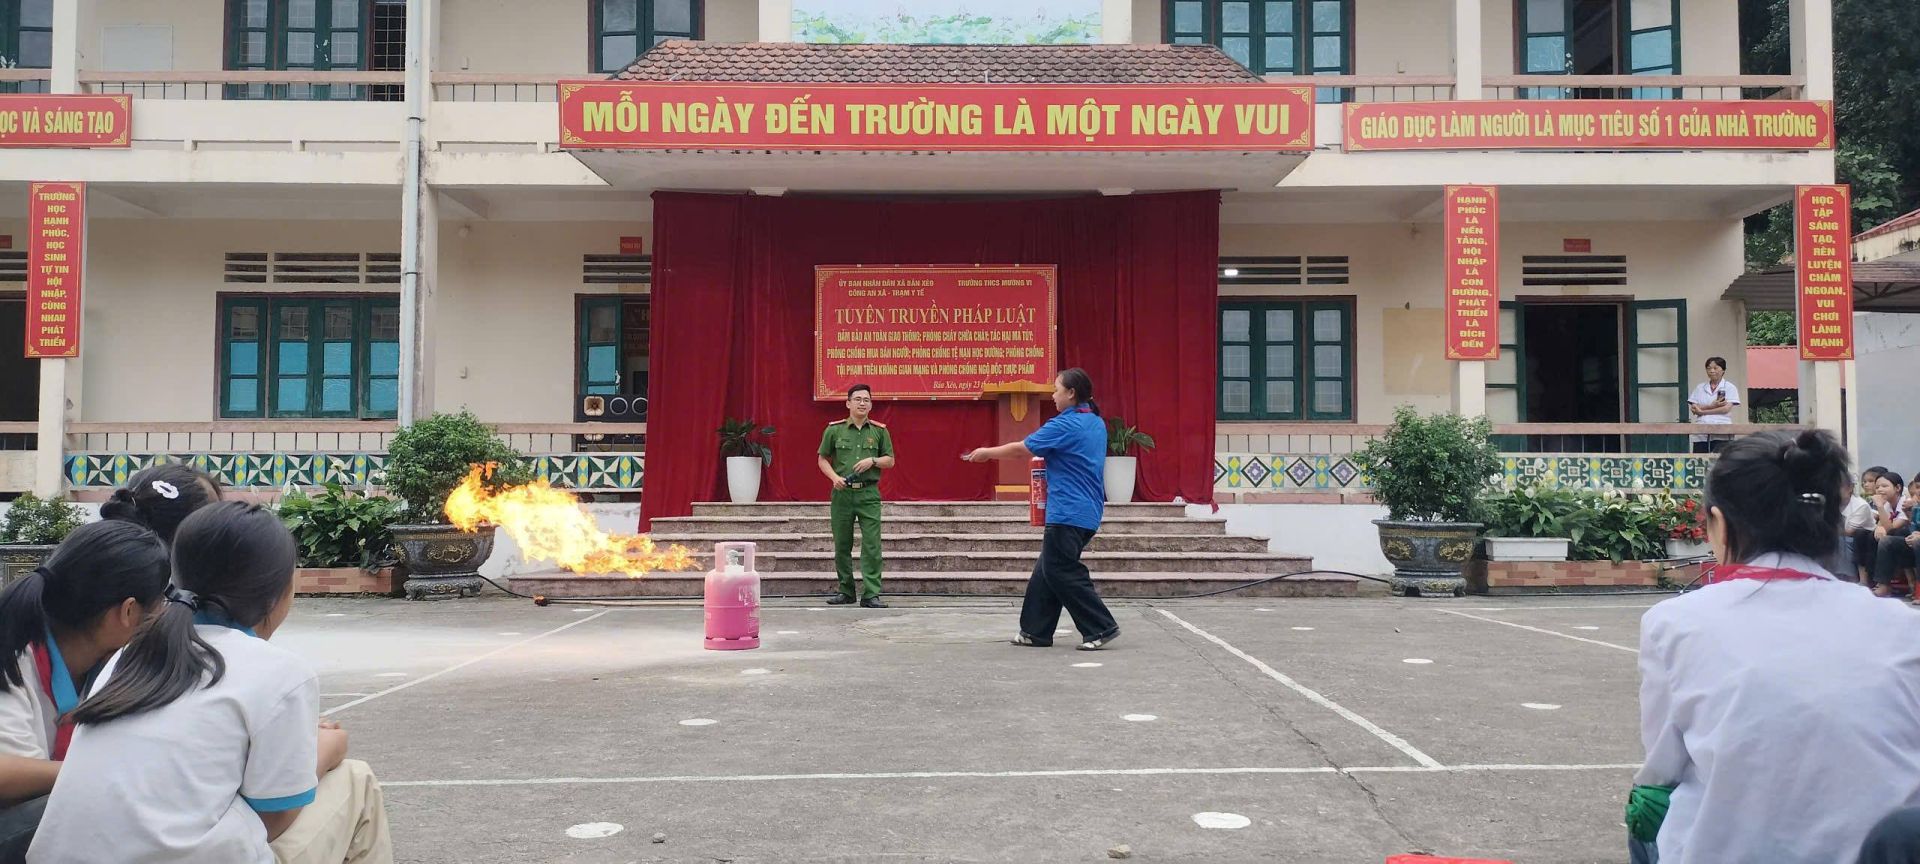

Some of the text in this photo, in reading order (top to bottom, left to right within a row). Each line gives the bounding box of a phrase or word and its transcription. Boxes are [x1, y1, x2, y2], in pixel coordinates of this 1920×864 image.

[582, 91, 1289, 142] MỖI NGÀY ĐẾN TRƯỜNG LÀ MỘT NGÀY VUI
[22, 106, 40, 133] VÀ
[45, 106, 83, 133] SÁNG
[88, 111, 114, 138] TẠO
[1360, 106, 1817, 142] GIÁO DỤC LÀM NGƯỜI LÀ MỤC TIÊU SỐ 1 CỦA NHÀ TRƯỜNG
[39, 192, 75, 200] TRƯỜNG
[1457, 196, 1486, 204] HẠNH
[1812, 196, 1834, 206] HỌC
[48, 205, 66, 214] HỌC
[1458, 206, 1486, 214] PHÚC
[1813, 208, 1833, 219] TẬP
[44, 217, 69, 226] HẠNH
[1465, 216, 1478, 224] LÀ
[1809, 220, 1838, 230] SÁNG
[1461, 226, 1483, 234] NỀN
[46, 242, 64, 250] HỌC
[1463, 247, 1481, 255] HỘI
[1814, 246, 1835, 256] RÈN
[1458, 257, 1487, 266] NHẬP
[1808, 259, 1841, 270] LUYỆN
[40, 265, 53, 275] TỰ
[1466, 267, 1479, 275] LÀ
[1809, 272, 1841, 282] CHĂM
[47, 277, 62, 287] HỘI
[863, 279, 881, 287] NHÂN
[958, 278, 983, 287] TRƯỜNG
[848, 289, 866, 297] CÔNG
[892, 290, 910, 298] TRẠM
[917, 288, 925, 297] TẾ
[41, 301, 66, 310] CÙNG
[1459, 298, 1486, 306] PHÁT
[1816, 300, 1835, 308] VUI
[835, 299, 1036, 327] TUYÊN TRUYỀN PHÁP LUẬT
[1456, 308, 1488, 316] TRIỂN
[1813, 312, 1839, 320] CHƠI
[41, 314, 65, 322] NHAU
[1466, 319, 1479, 327] LÀ
[42, 325, 64, 334] PHÁT
[1812, 324, 1841, 333] LÀNH
[864, 332, 872, 342] AN
[872, 330, 887, 342] TOÀN
[888, 331, 900, 341] GIAO
[923, 330, 942, 341] PHÒNG
[943, 329, 957, 341] CHÁY
[990, 329, 1001, 341] TÁC
[1012, 331, 1022, 341] MA
[40, 336, 66, 347] TRIỂN
[1462, 339, 1483, 348] ĐẾN
[1810, 338, 1843, 348] MẠNH
[826, 346, 846, 359] PHÒNG
[846, 345, 866, 358] CHỐNG
[866, 348, 879, 358] MUA
[880, 346, 892, 358] BÁN
[912, 346, 931, 358] PHÒNG
[931, 344, 951, 358] CHỐNG
[972, 348, 983, 360] HỌC
[1006, 345, 1024, 357] PHÒNG
[1026, 344, 1044, 357] CHỐNG
[836, 364, 846, 377] TỘI
[847, 365, 863, 377] PHẠM
[863, 363, 878, 375] TRÊN
[879, 363, 897, 375] KHÔNG
[898, 365, 912, 375] GIAN
[912, 365, 929, 376] MẠNG
[930, 363, 938, 375] VÀ
[939, 363, 958, 374] PHÒNG
[958, 361, 978, 374] CHỐNG
